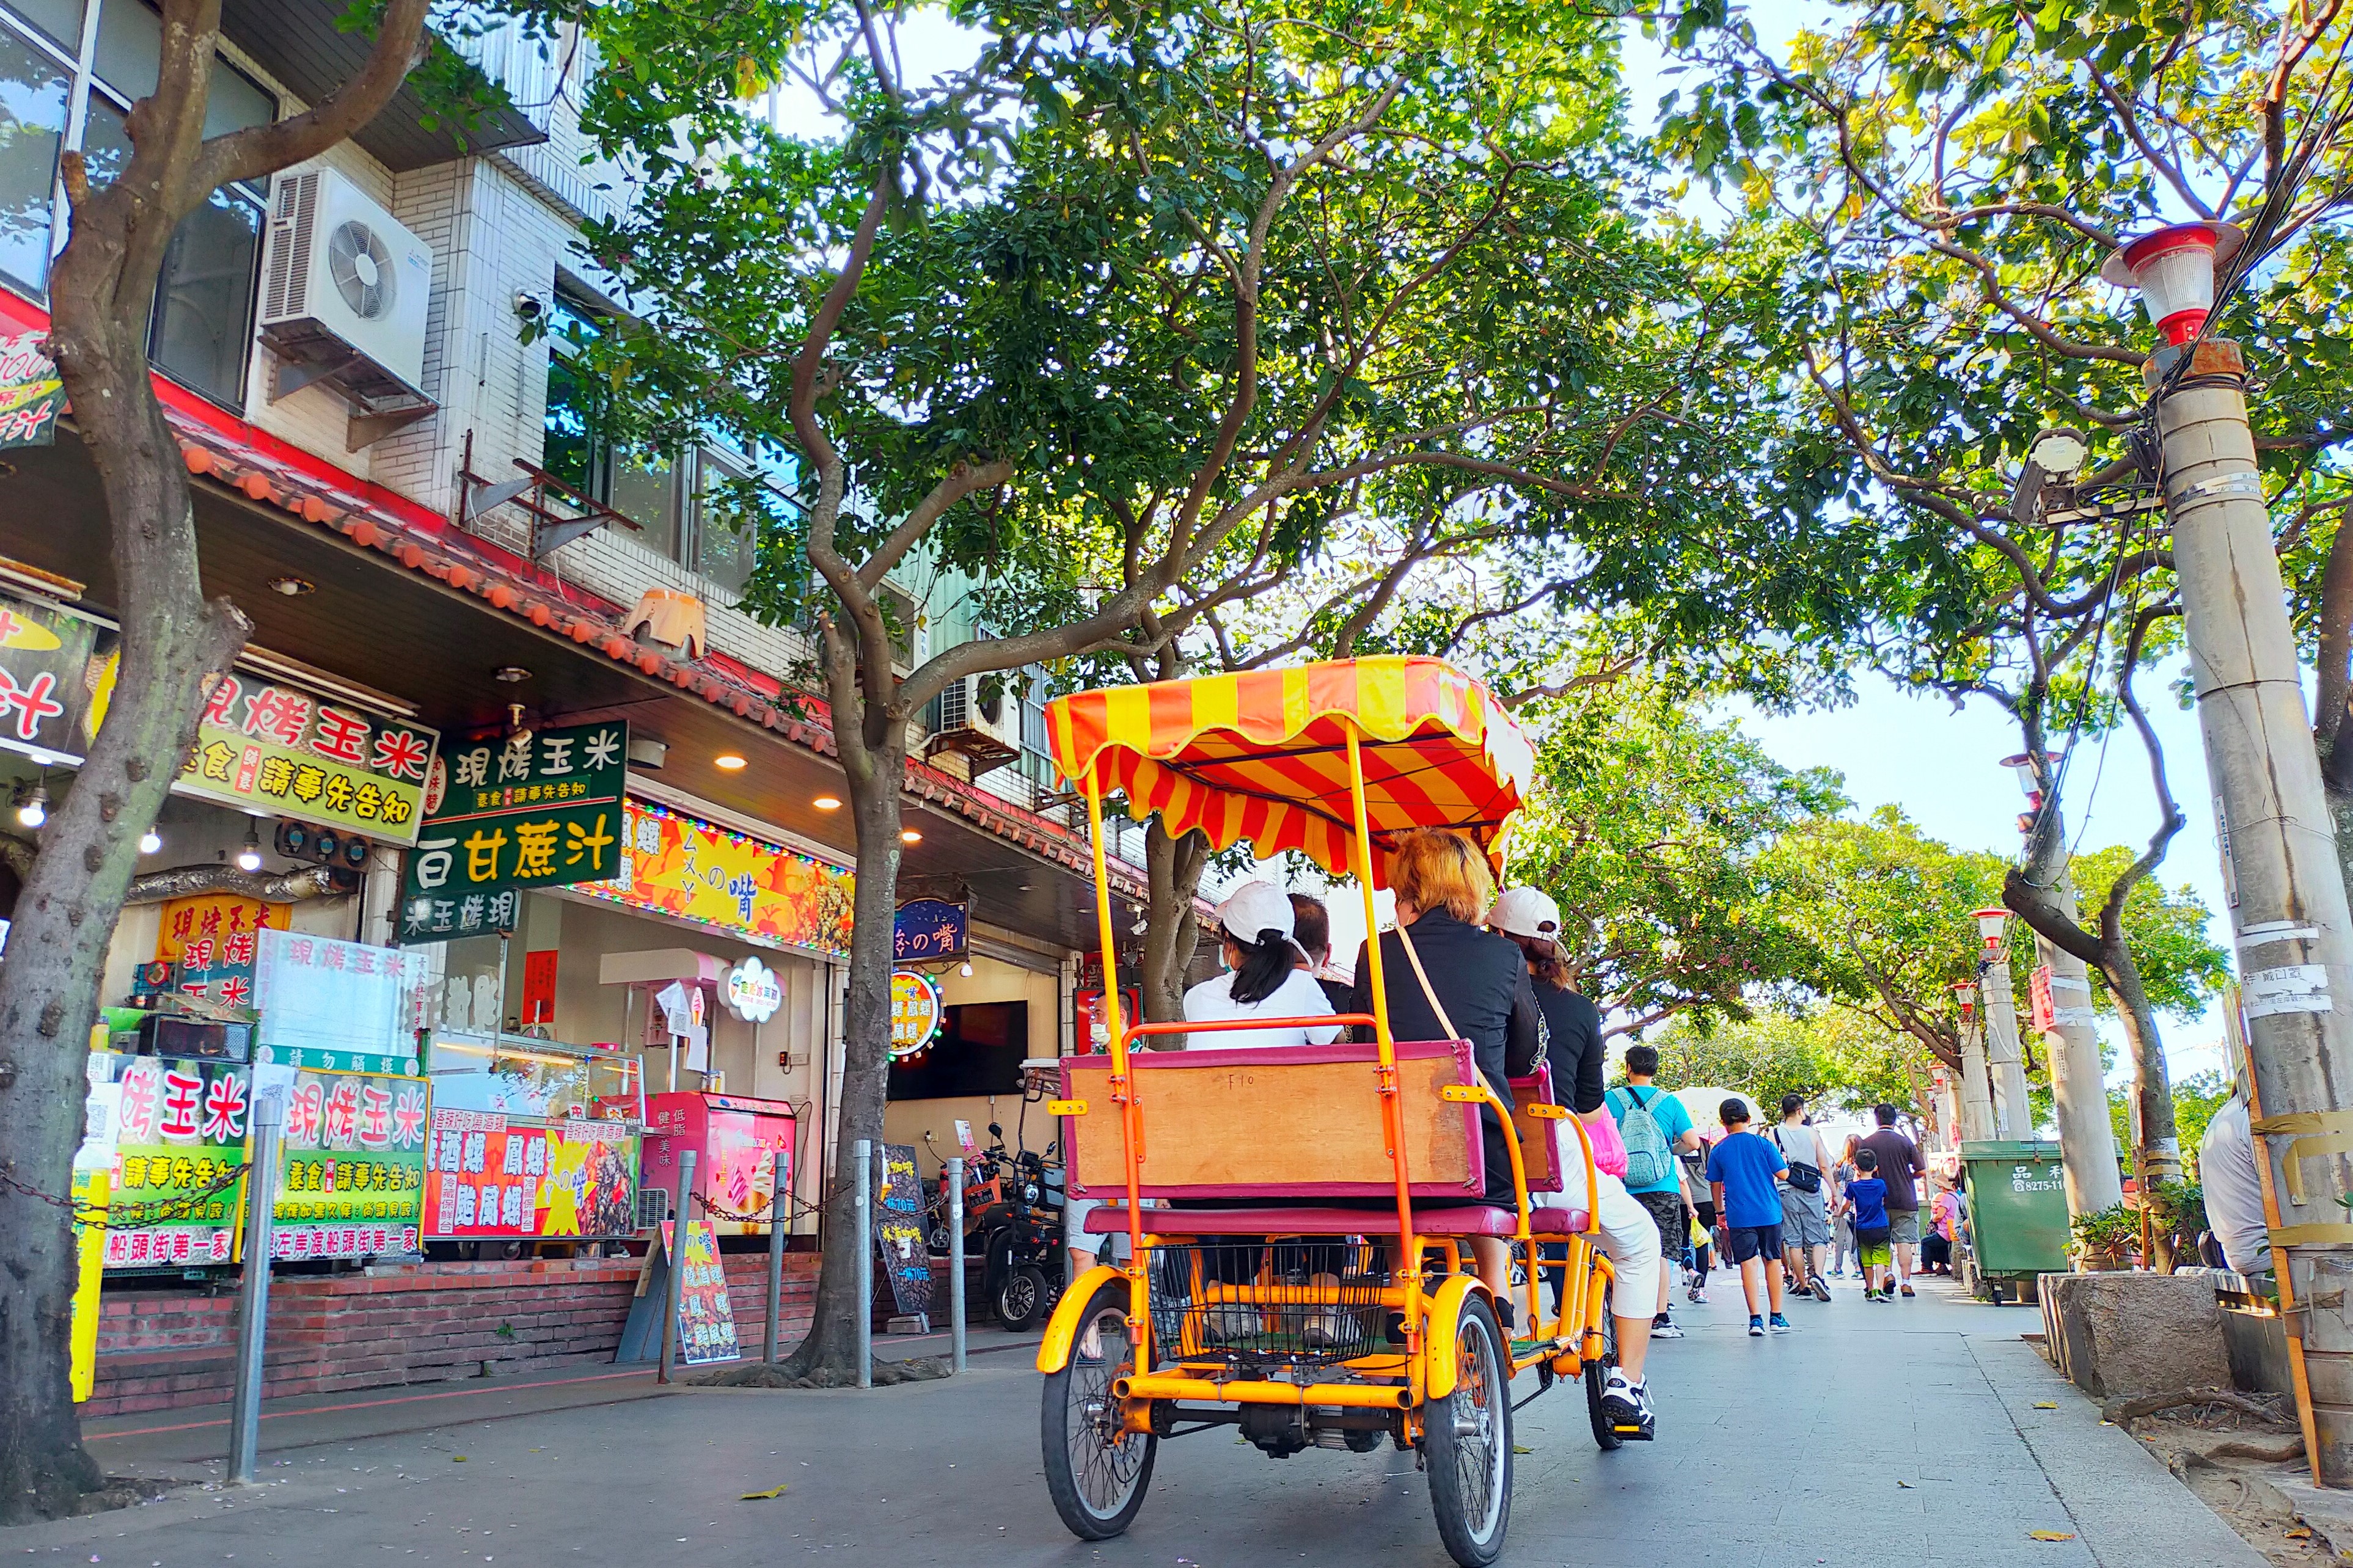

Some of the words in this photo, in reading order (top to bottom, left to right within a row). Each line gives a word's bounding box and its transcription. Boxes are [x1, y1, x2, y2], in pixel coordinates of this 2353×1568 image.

[455, 729, 620, 787] 現烤玉米
[259, 756, 411, 823] 請事先告知
[513, 781, 587, 804] 請事先告知
[290, 939, 406, 977] 現烤玉米
[289, 1048, 394, 1075] 請勿觸摸
[287, 1082, 425, 1147] 現烤玉米
[657, 1110, 672, 1167] 健美味
[125, 1155, 235, 1189] 請事先告知
[288, 1159, 323, 1191] 素食
[335, 1161, 422, 1191] 請事先告知
[887, 1161, 915, 1178] 咖啡
[2025, 1180, 2065, 1191] 8275-11
[440, 1176, 456, 1231] 冷藏保鮮台
[109, 1232, 231, 1261] 船頭街第一家
